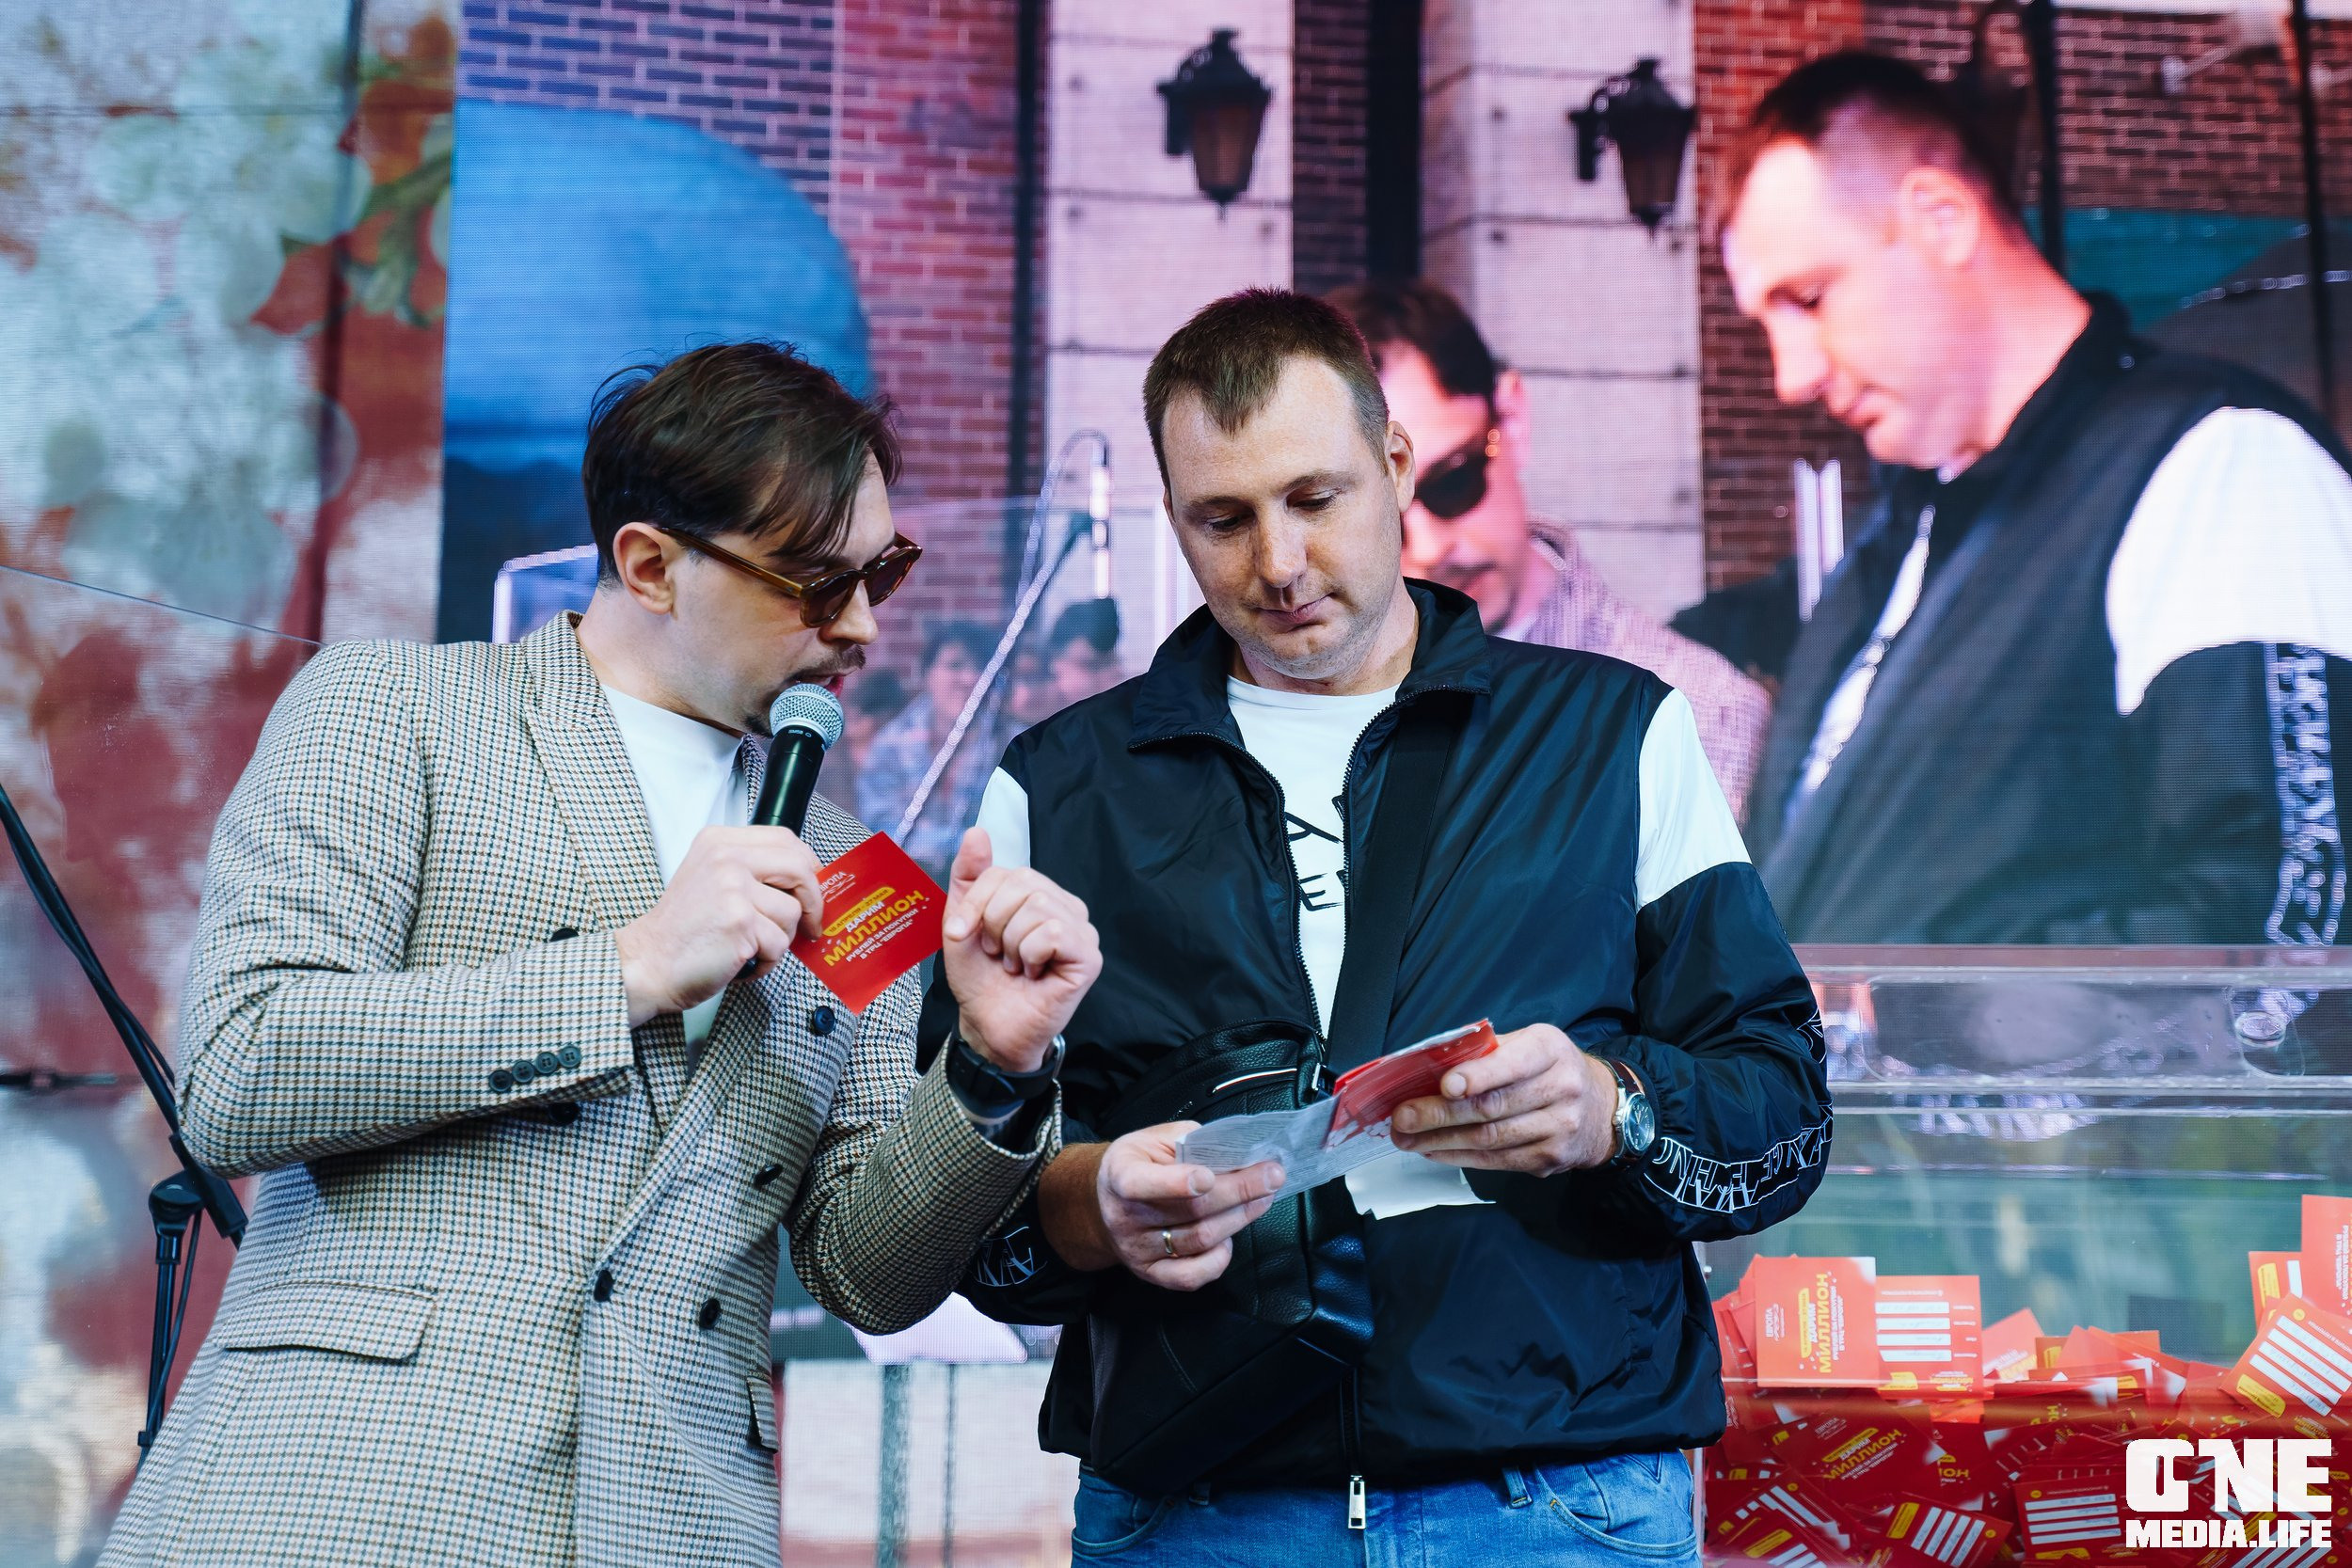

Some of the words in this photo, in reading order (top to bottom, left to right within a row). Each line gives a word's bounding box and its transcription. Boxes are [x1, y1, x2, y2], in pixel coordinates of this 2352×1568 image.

[823, 890, 925, 966] МИЛЛИОН
[845, 901, 884, 932] ДАРИМ
[883, 909, 919, 933] ПОКУПКИ
[1817, 1274, 1832, 1373] МИЛЛИОН
